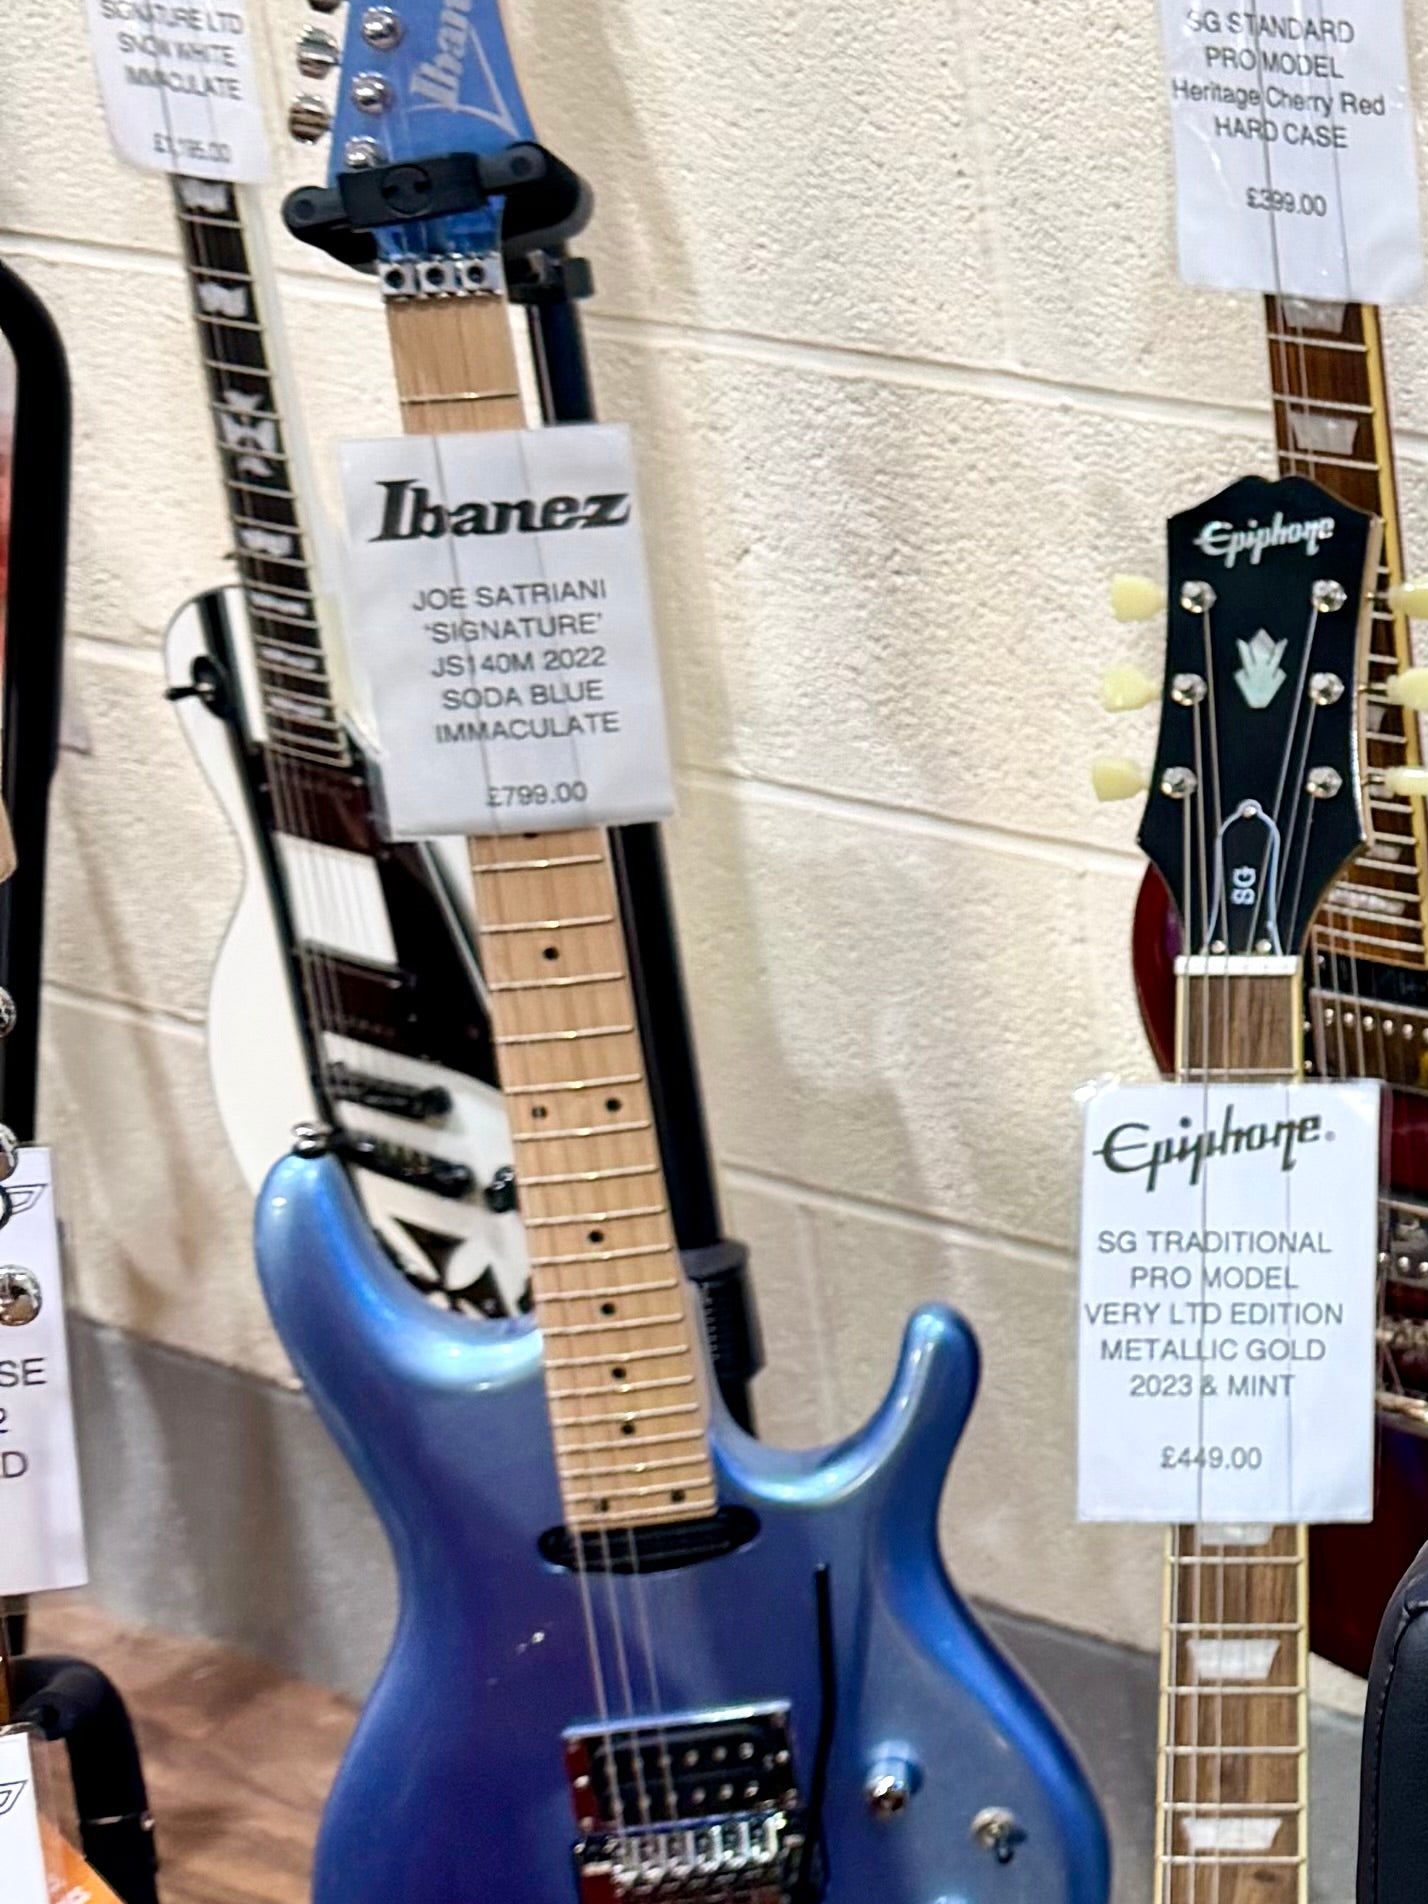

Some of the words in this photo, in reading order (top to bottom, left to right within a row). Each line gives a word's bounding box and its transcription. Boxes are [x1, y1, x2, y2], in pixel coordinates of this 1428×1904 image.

[1187, 9, 1222, 34] SG
[1228, 10, 1355, 43] STANDARD
[1205, 47, 1257, 71] PRO
[1263, 53, 1344, 79] MODEL
[1172, 78, 1259, 110] Heritage
[1266, 86, 1334, 118] Cherry
[1341, 92, 1386, 116] Red
[1214, 116, 1279, 143] HARD
[1284, 122, 1349, 149] CASE
[368, 478, 632, 542] Ibanez
[1193, 511, 1335, 568] Epiphone
[412, 587, 468, 611] JOE
[475, 579, 607, 608] SATRIANI
[432, 652, 535, 678] JS140M
[543, 647, 607, 671] 2022
[442, 686, 523, 710] SODA
[530, 680, 605, 705] BLUE
[434, 711, 621, 744] IMMACULATE
[1231, 865, 1257, 906] SG
[1092, 1104, 1322, 1192] Epiphone
[1097, 1230, 1138, 1254] SG
[1147, 1230, 1333, 1254] TRADITIONAL
[1130, 1266, 1192, 1289] PRO
[1202, 1266, 1300, 1289] MODEL
[1085, 1302, 1161, 1325] VERY
[1170, 1302, 1222, 1325] LTD
[1230, 1302, 1344, 1325] EDITION
[1100, 1338, 1239, 1361] METALLIC
[1246, 1338, 1327, 1361] GOLD
[0, 1357, 47, 1388] SE
[1130, 1374, 1193, 1397] 2023
[1200, 1374, 1218, 1397] &
[1228, 1374, 1296, 1397] MINT
[1, 1450, 29, 1480] D
[1160, 1446, 1262, 1470] £449.00
